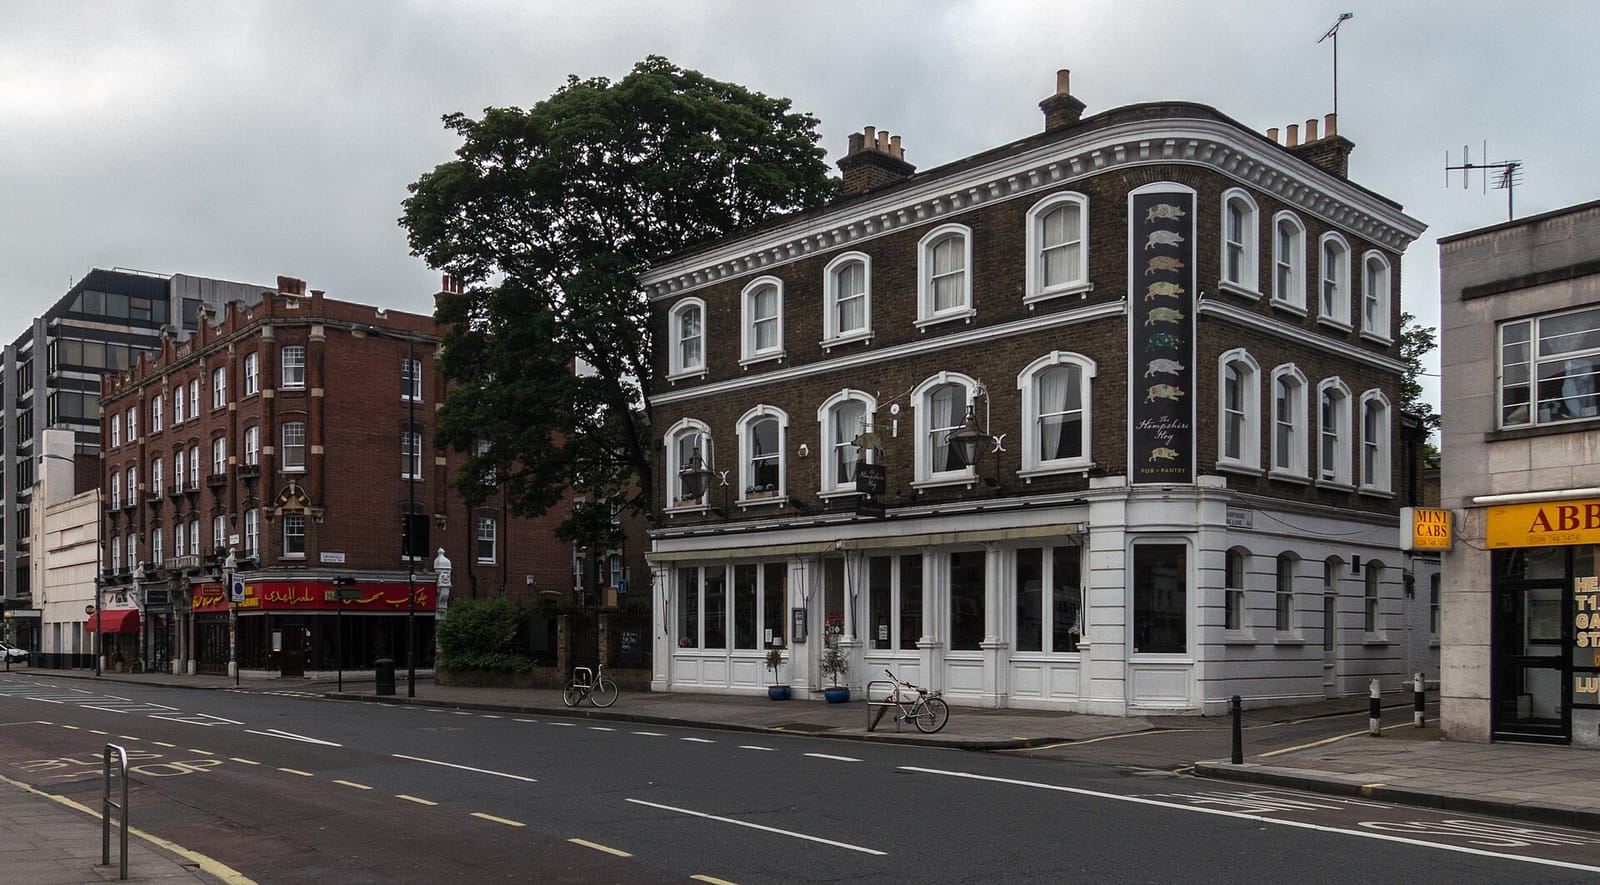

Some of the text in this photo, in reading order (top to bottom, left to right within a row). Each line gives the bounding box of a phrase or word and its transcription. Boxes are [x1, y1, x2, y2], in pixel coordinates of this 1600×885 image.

[1135, 418, 1190, 432] Hampshire
[1153, 431, 1175, 446] Hog
[1416, 510, 1447, 523] MINI
[1416, 524, 1447, 537] CABS
[1574, 576, 1600, 592] HE
[1576, 631, 1600, 648] ST
